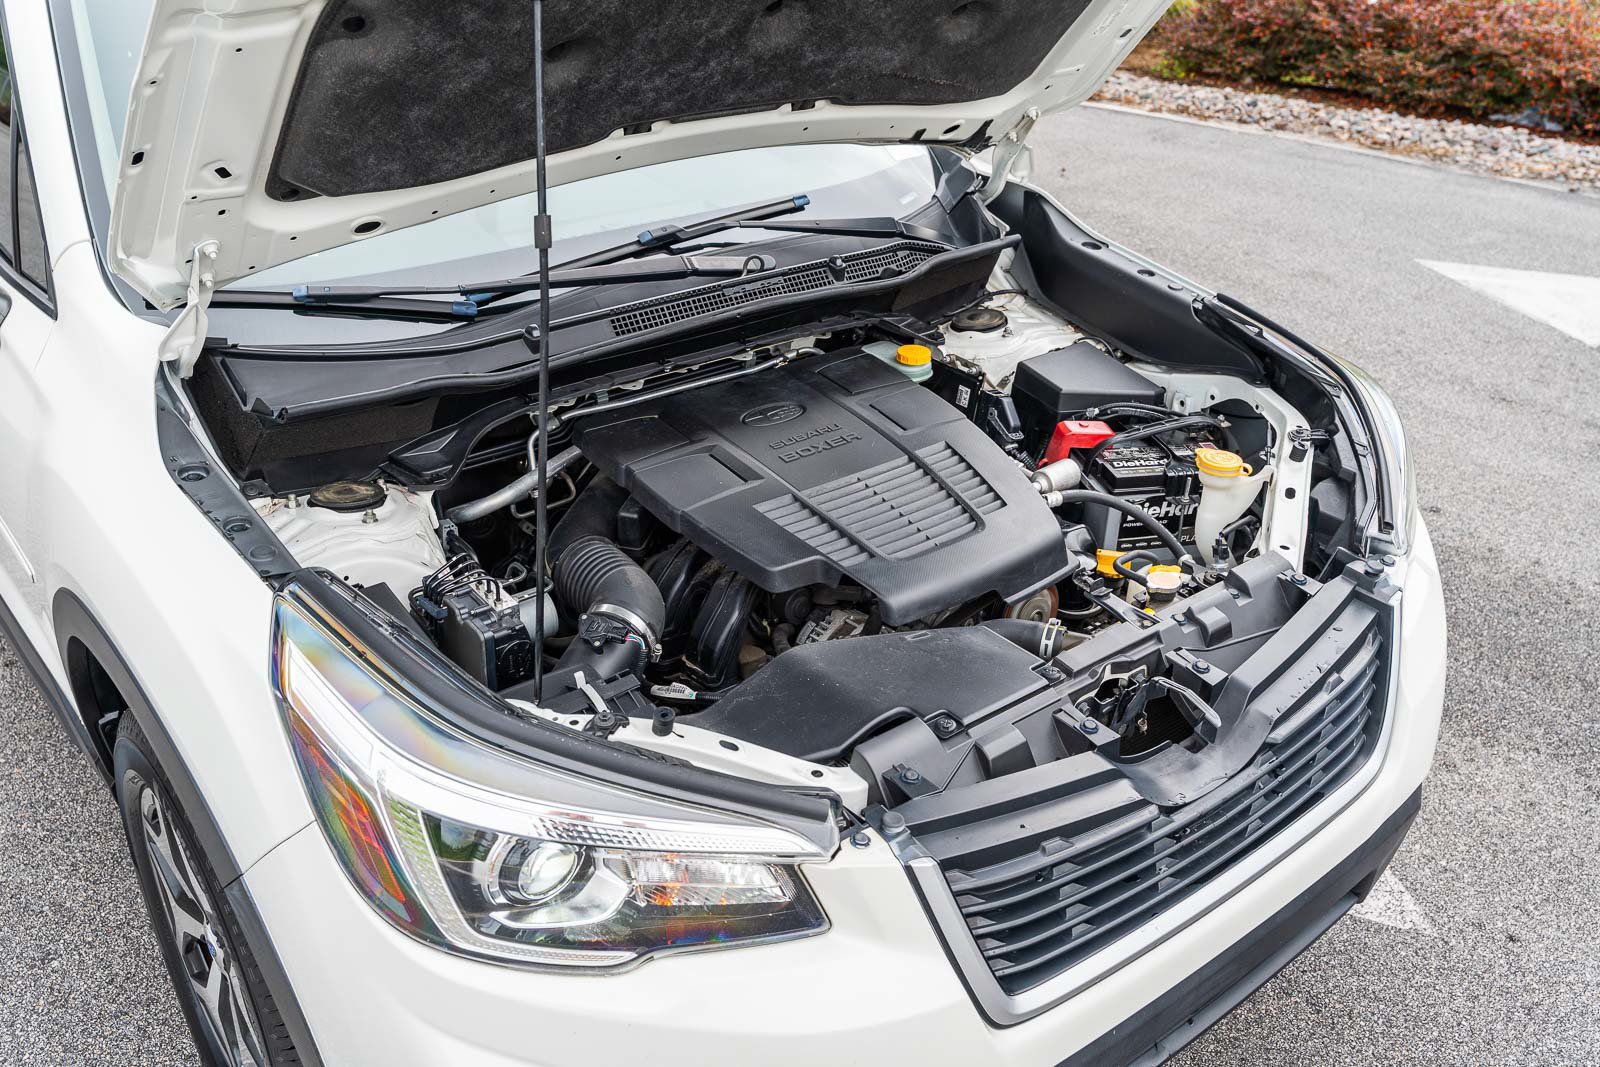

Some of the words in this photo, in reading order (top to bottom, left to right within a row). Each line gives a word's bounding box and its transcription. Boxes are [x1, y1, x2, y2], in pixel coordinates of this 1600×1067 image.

[769, 423, 843, 449] SUBARU
[778, 431, 863, 463] BOXER
[1112, 458, 1168, 468] DieHard
